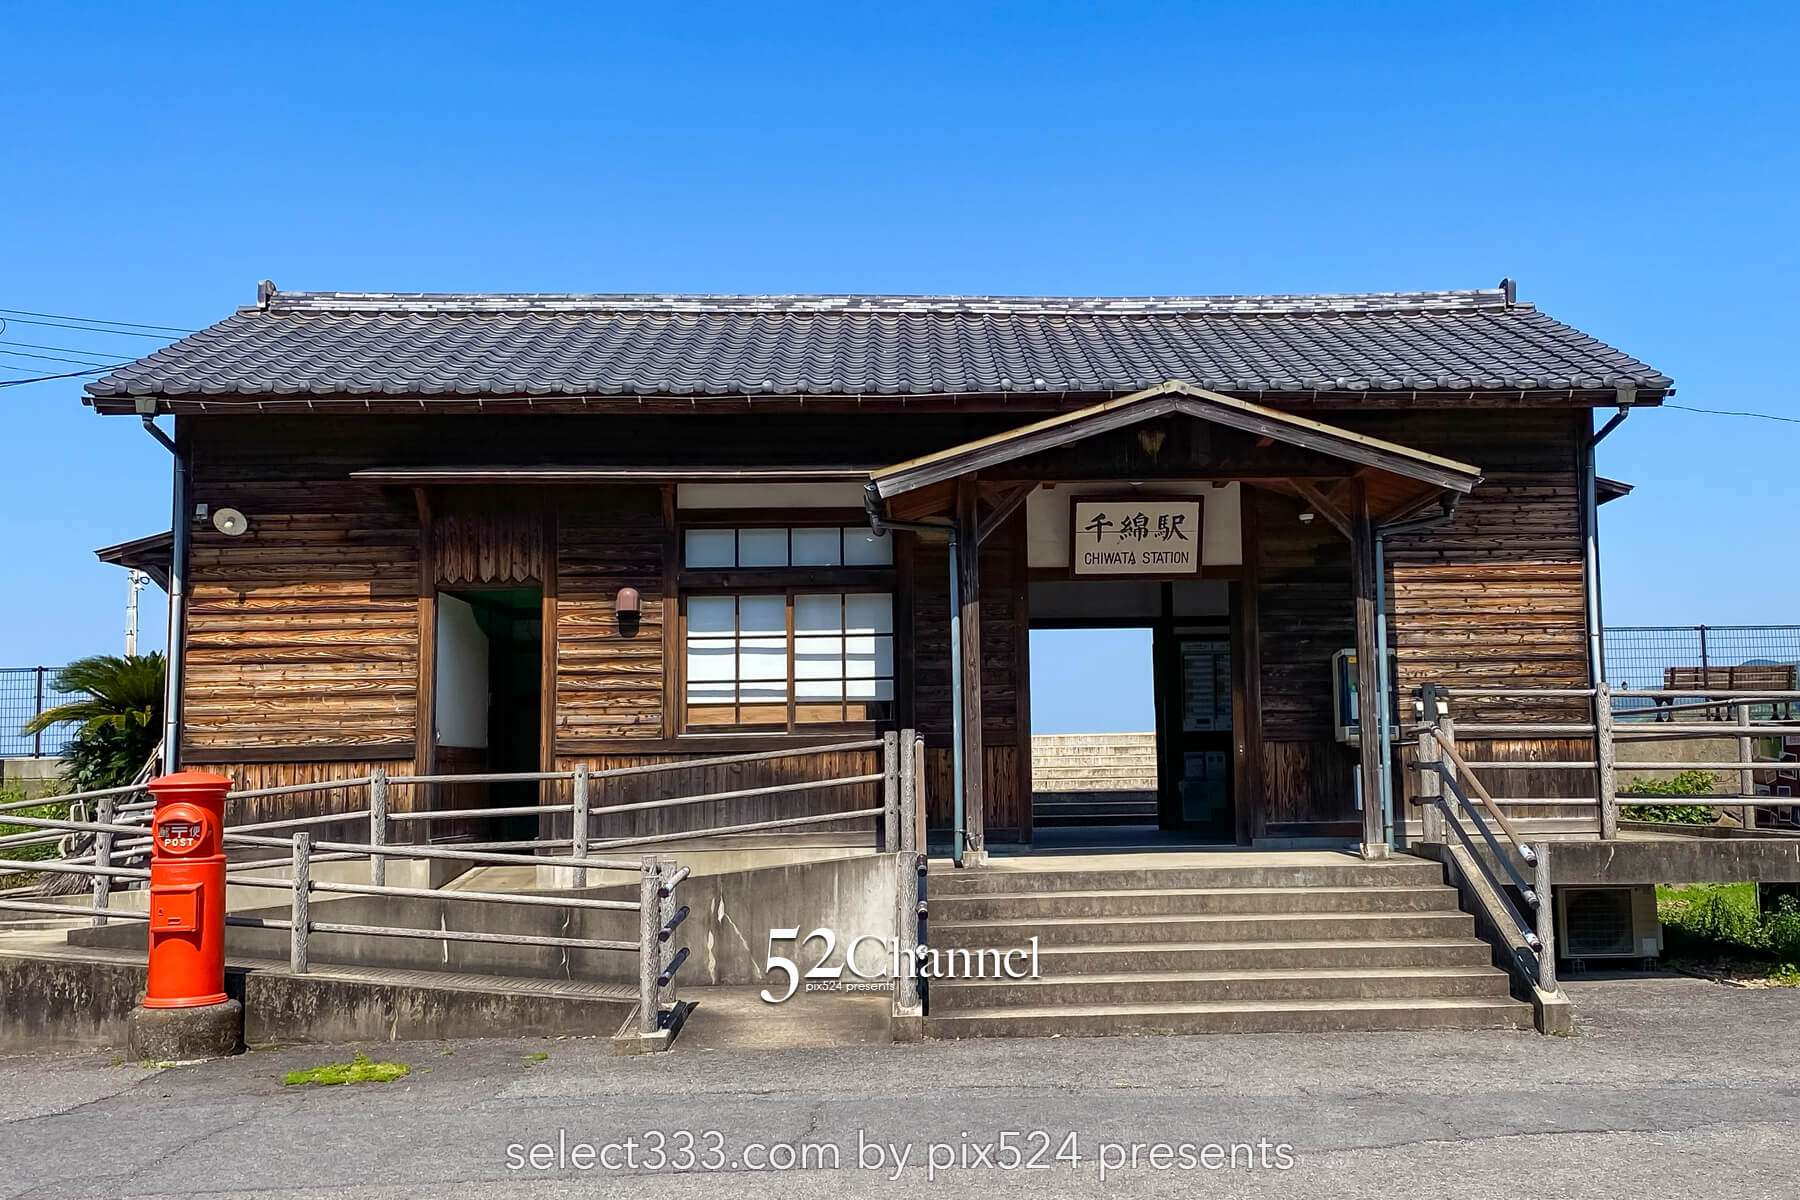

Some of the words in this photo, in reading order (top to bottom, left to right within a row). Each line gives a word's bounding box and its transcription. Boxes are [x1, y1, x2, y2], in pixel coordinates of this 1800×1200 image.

[1085, 512, 1189, 543] 千綿駅
[1084, 552, 1136, 565] CHIWATA
[1142, 551, 1189, 564] STATION
[164, 837, 194, 847] POST
